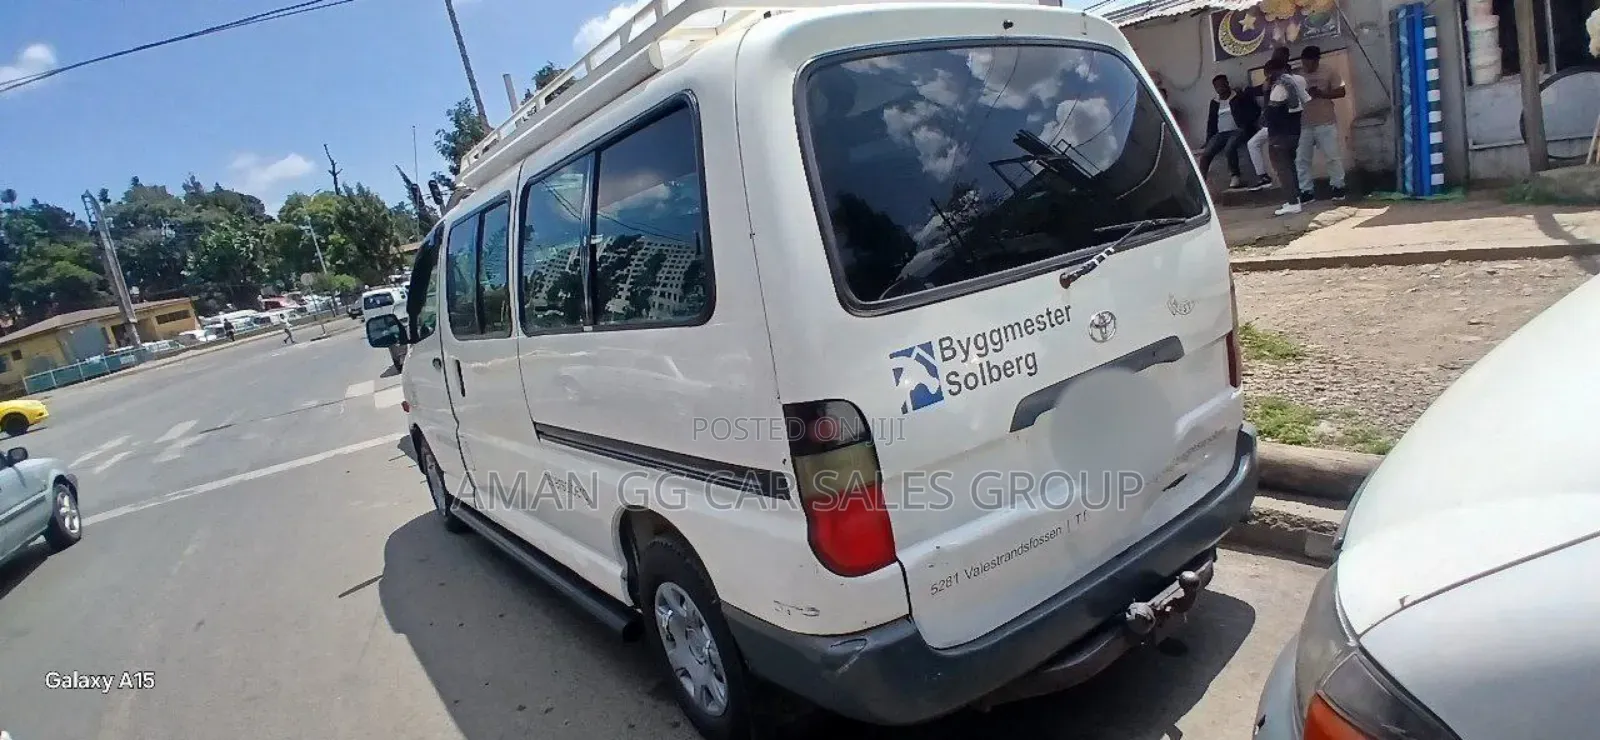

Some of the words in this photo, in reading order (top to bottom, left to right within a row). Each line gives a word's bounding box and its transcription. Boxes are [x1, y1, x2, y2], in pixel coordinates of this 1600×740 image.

[938, 304, 1072, 364] Byggmester
[945, 351, 1039, 396] Solberg
[930, 571, 960, 596] 5281
[964, 525, 1063, 581] Valestrandsfossen
